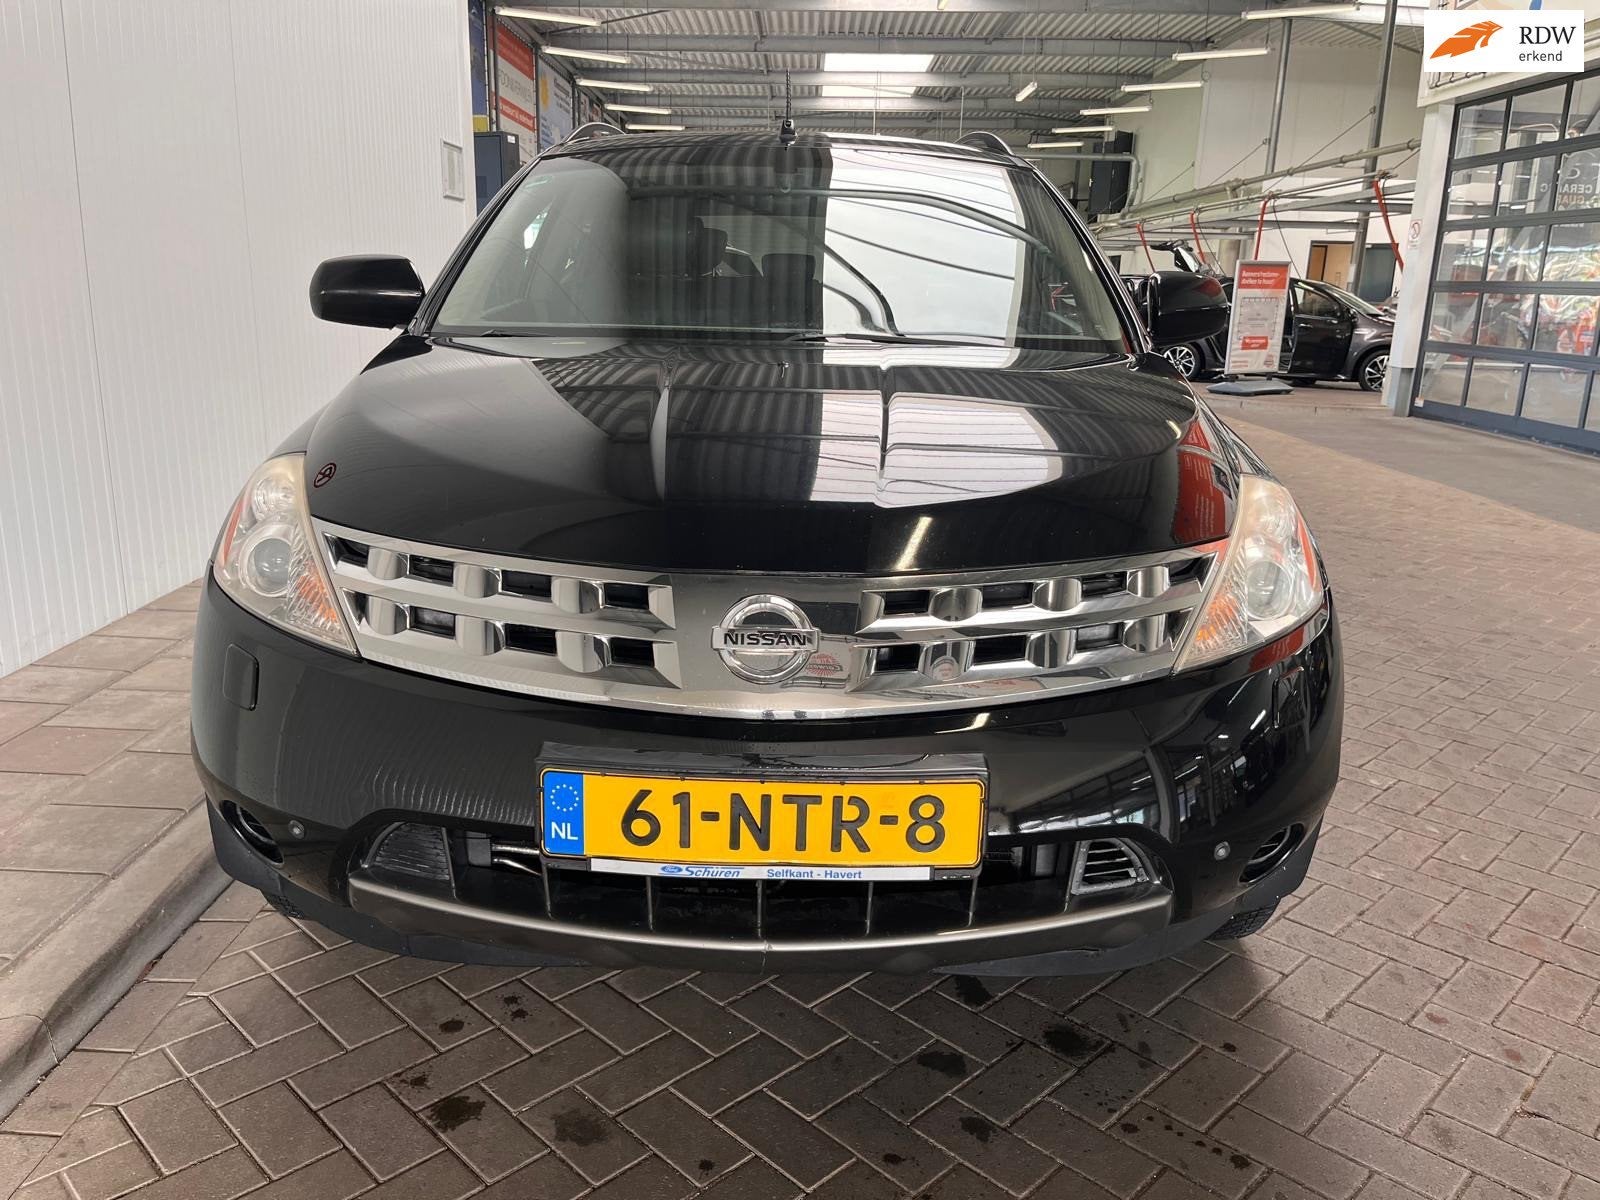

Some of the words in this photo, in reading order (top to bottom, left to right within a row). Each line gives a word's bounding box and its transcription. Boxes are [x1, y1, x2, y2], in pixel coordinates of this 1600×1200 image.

[723, 632, 807, 646] NISSAN
[620, 789, 947, 853] 61-NTR-8
[551, 821, 579, 841] NL
[767, 868, 814, 879] Selfkant
[824, 869, 863, 879] Havert
